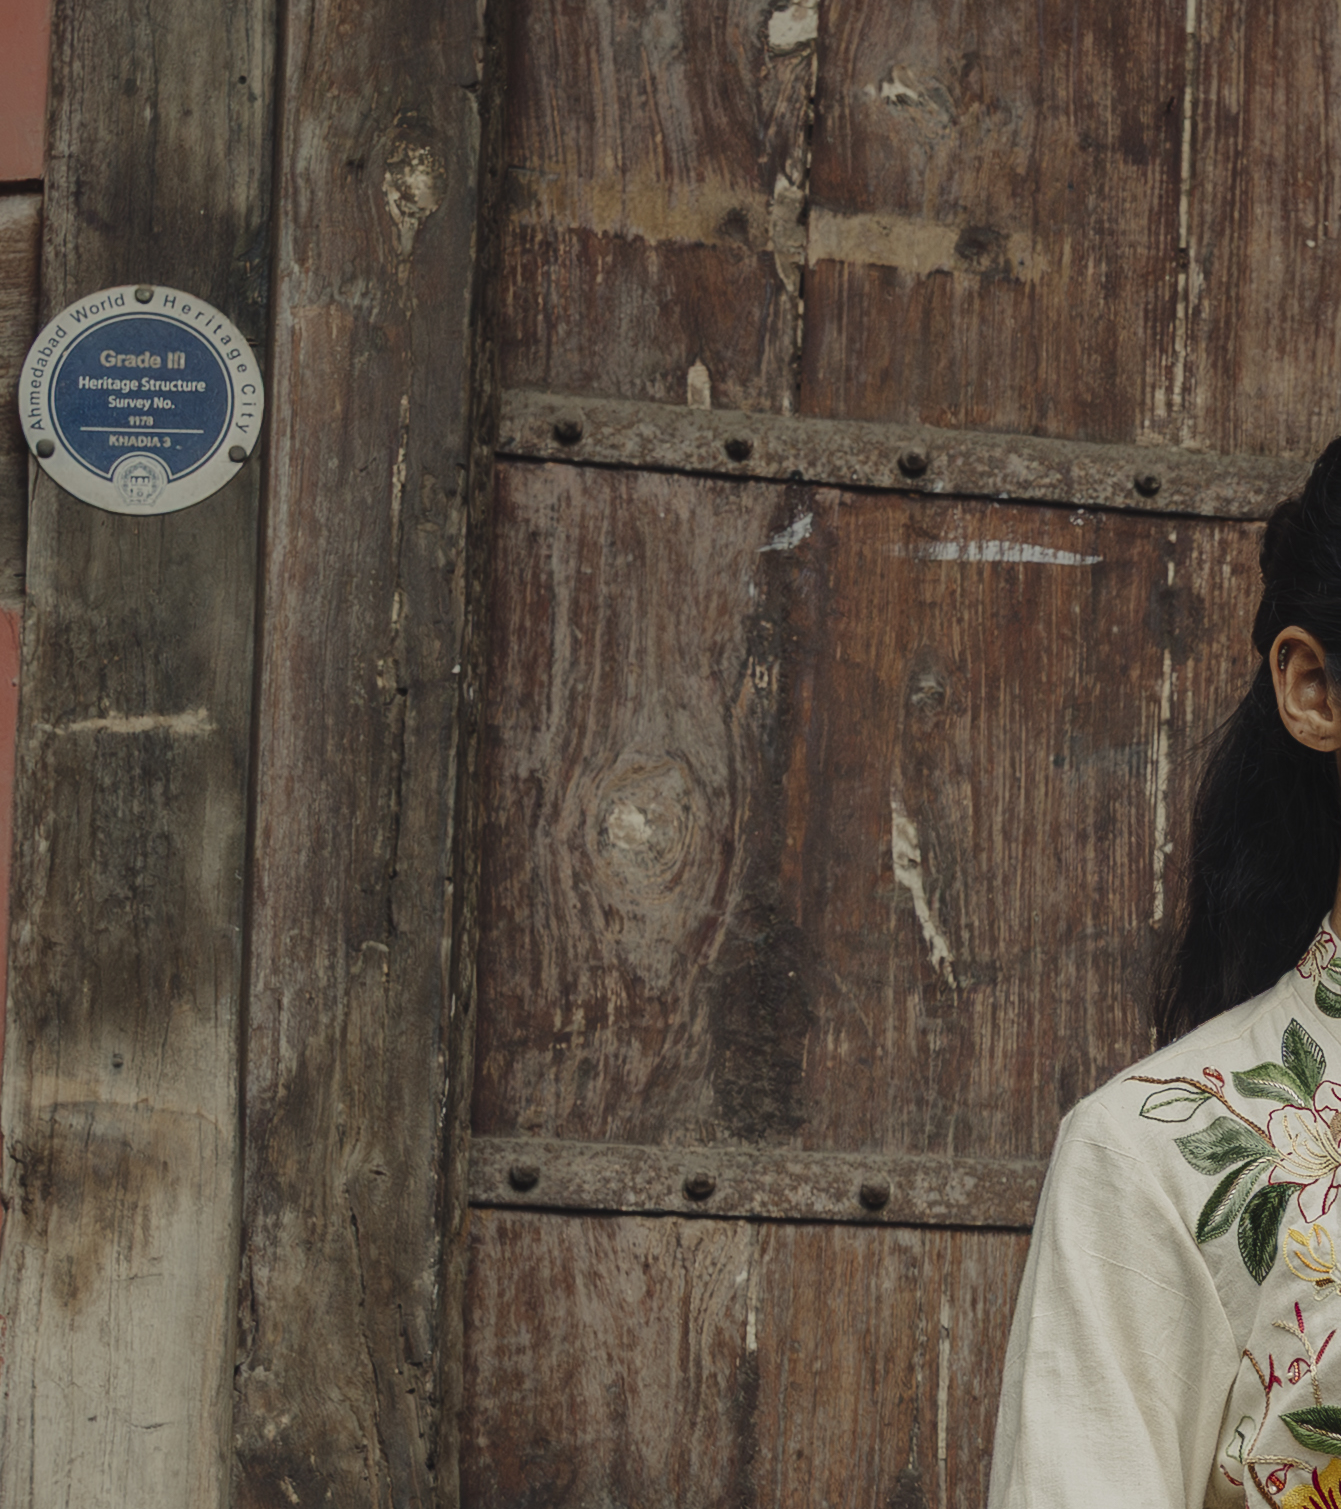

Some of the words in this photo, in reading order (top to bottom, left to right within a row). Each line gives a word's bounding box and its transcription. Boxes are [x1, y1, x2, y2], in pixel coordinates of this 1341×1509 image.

[28, 325, 68, 431] Ahmedabad
[69, 293, 125, 323] World
[163, 294, 248, 373] Heritage
[235, 383, 255, 434] City
[100, 350, 161, 368] Grade
[79, 376, 138, 393] Heritage
[141, 377, 206, 392] Structure
[108, 395, 151, 411] Survey
[153, 397, 175, 409] No.
[109, 434, 161, 447] KHADIA
[163, 437, 171, 448] 3
